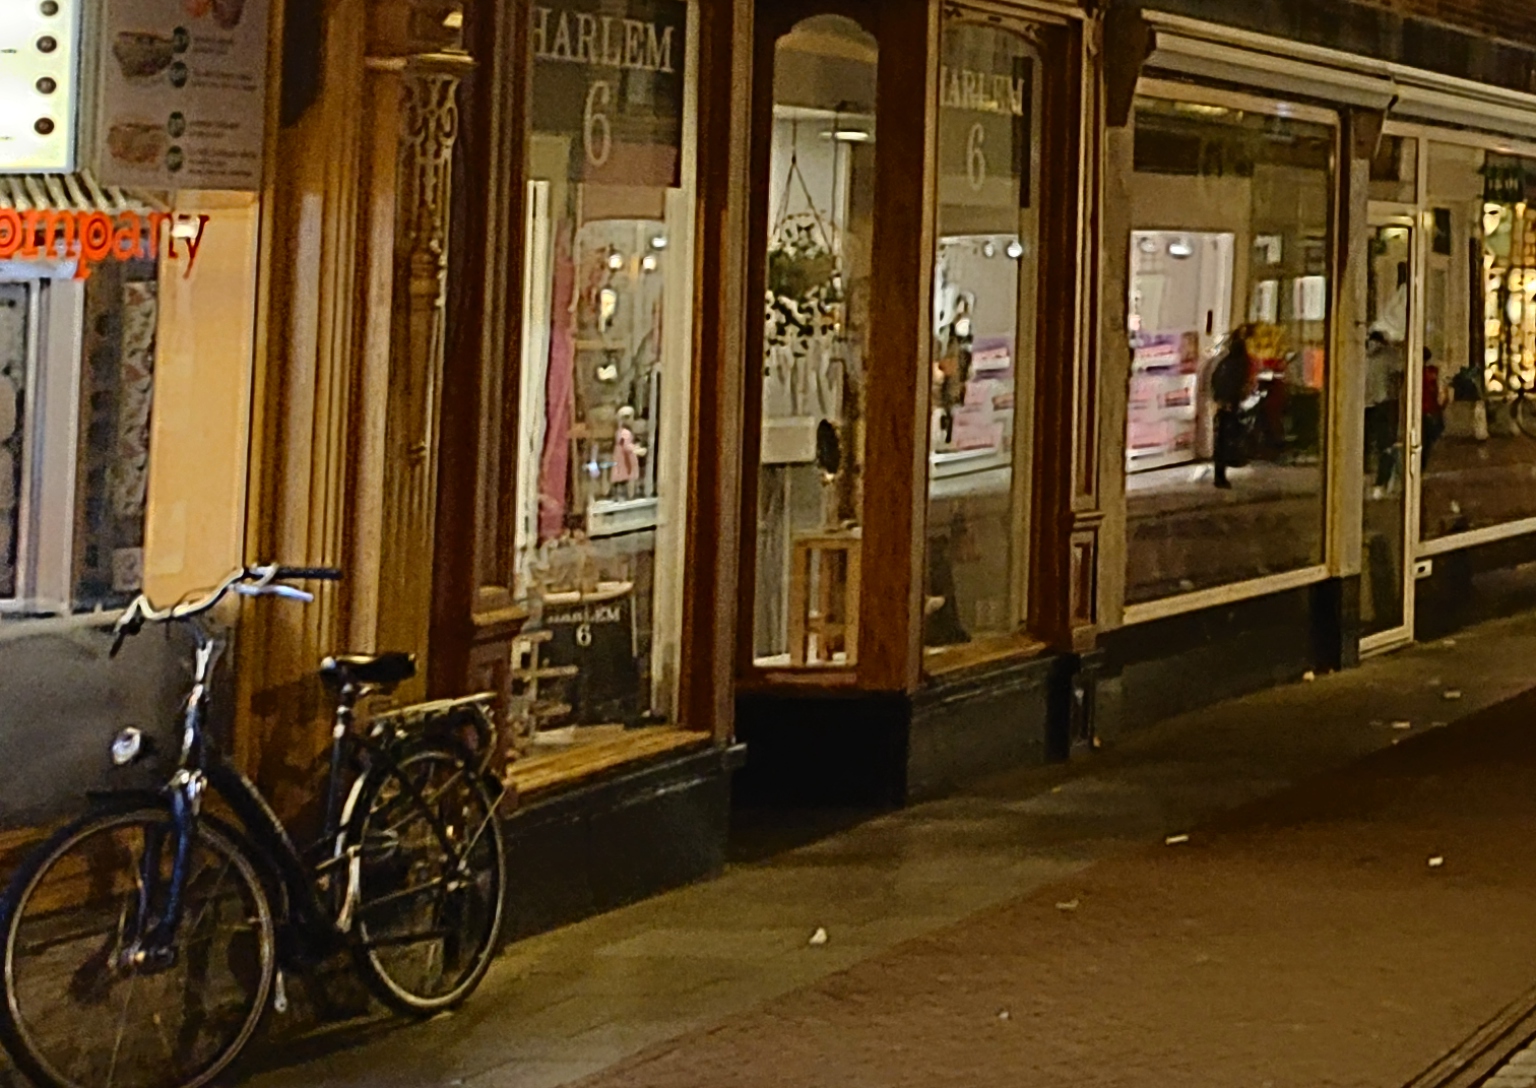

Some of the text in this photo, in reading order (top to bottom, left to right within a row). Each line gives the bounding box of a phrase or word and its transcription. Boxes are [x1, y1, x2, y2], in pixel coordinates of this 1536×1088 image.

[533, 6, 676, 73] HARLEM
[583, 80, 611, 166] 6
[966, 123, 985, 191] 6
[576, 624, 592, 647] 6
